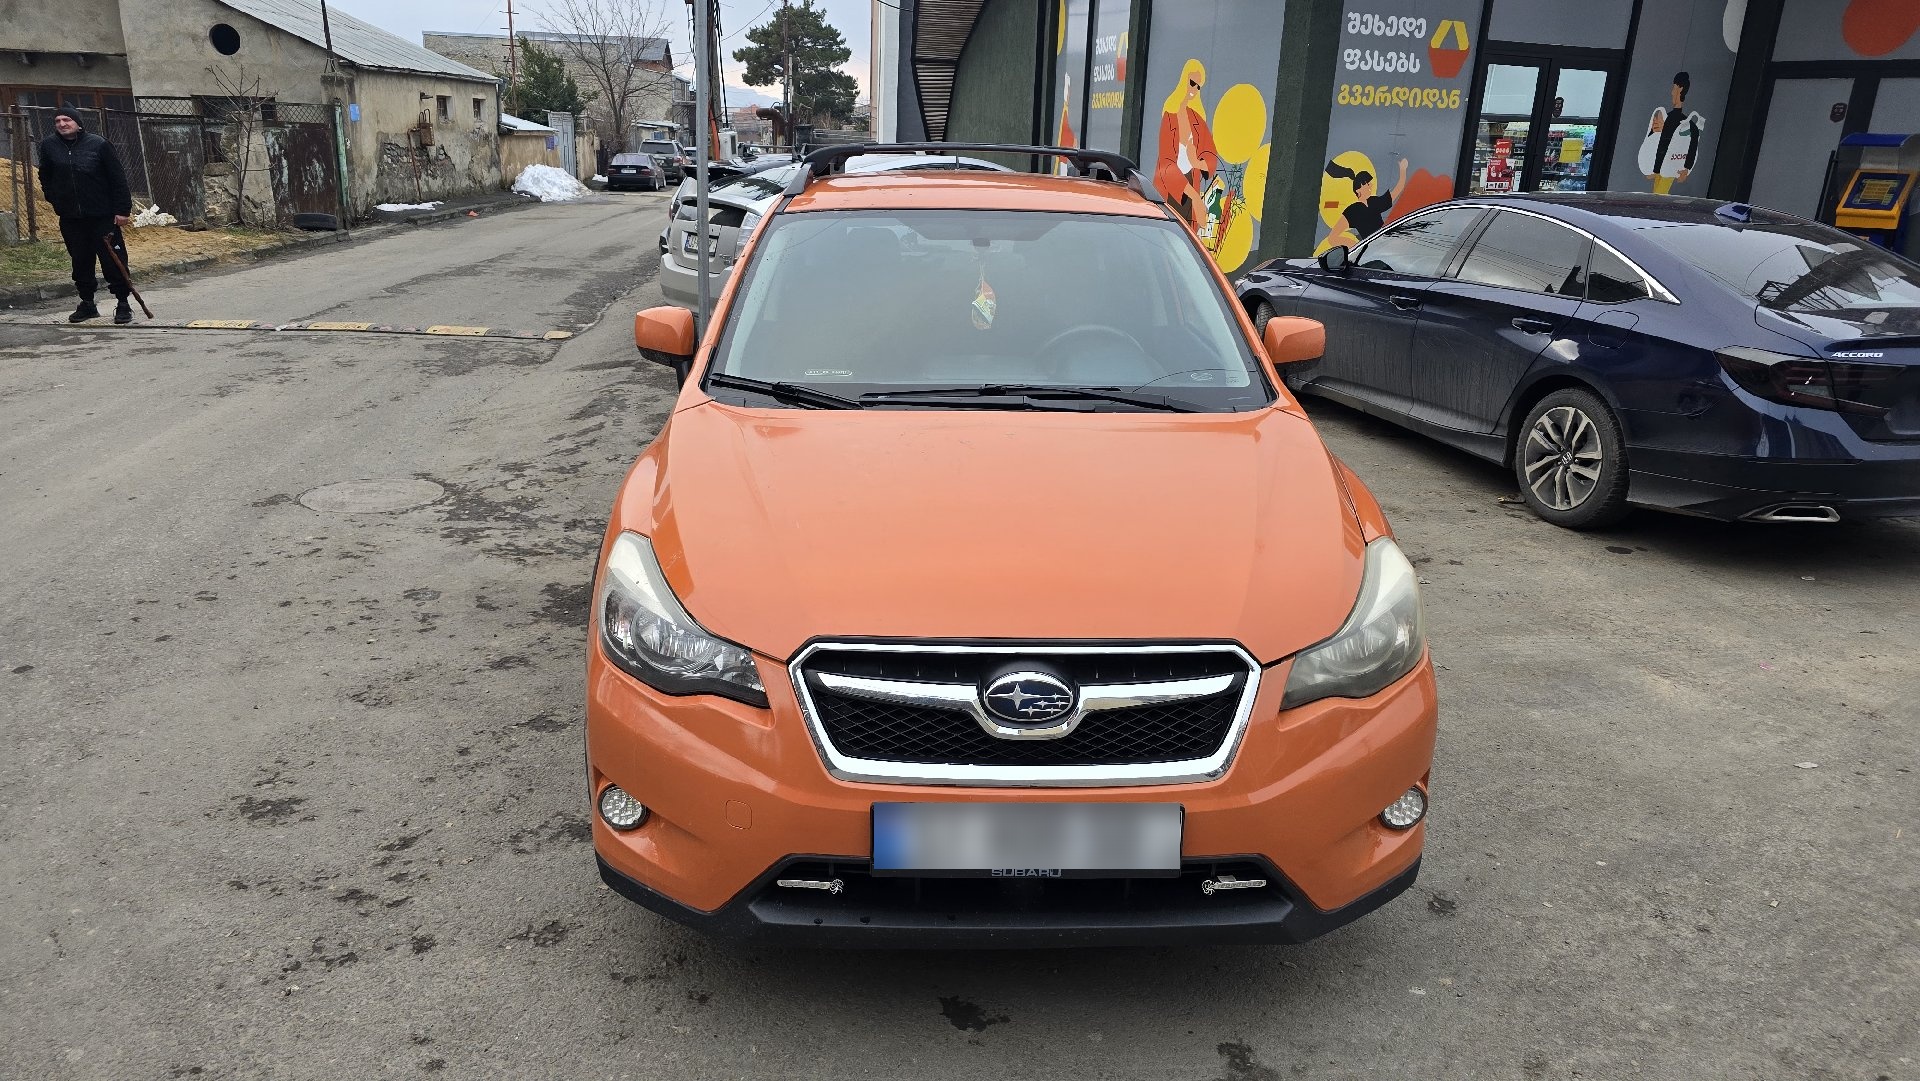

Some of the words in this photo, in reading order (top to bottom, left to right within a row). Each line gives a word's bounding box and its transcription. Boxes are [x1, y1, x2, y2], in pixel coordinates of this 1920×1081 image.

[1348, 12, 1426, 38] შეხედე
[1344, 49, 1420, 73] ფასებს
[1338, 84, 1460, 109] გვერდიდან
[991, 868, 1062, 877] SUBARU
